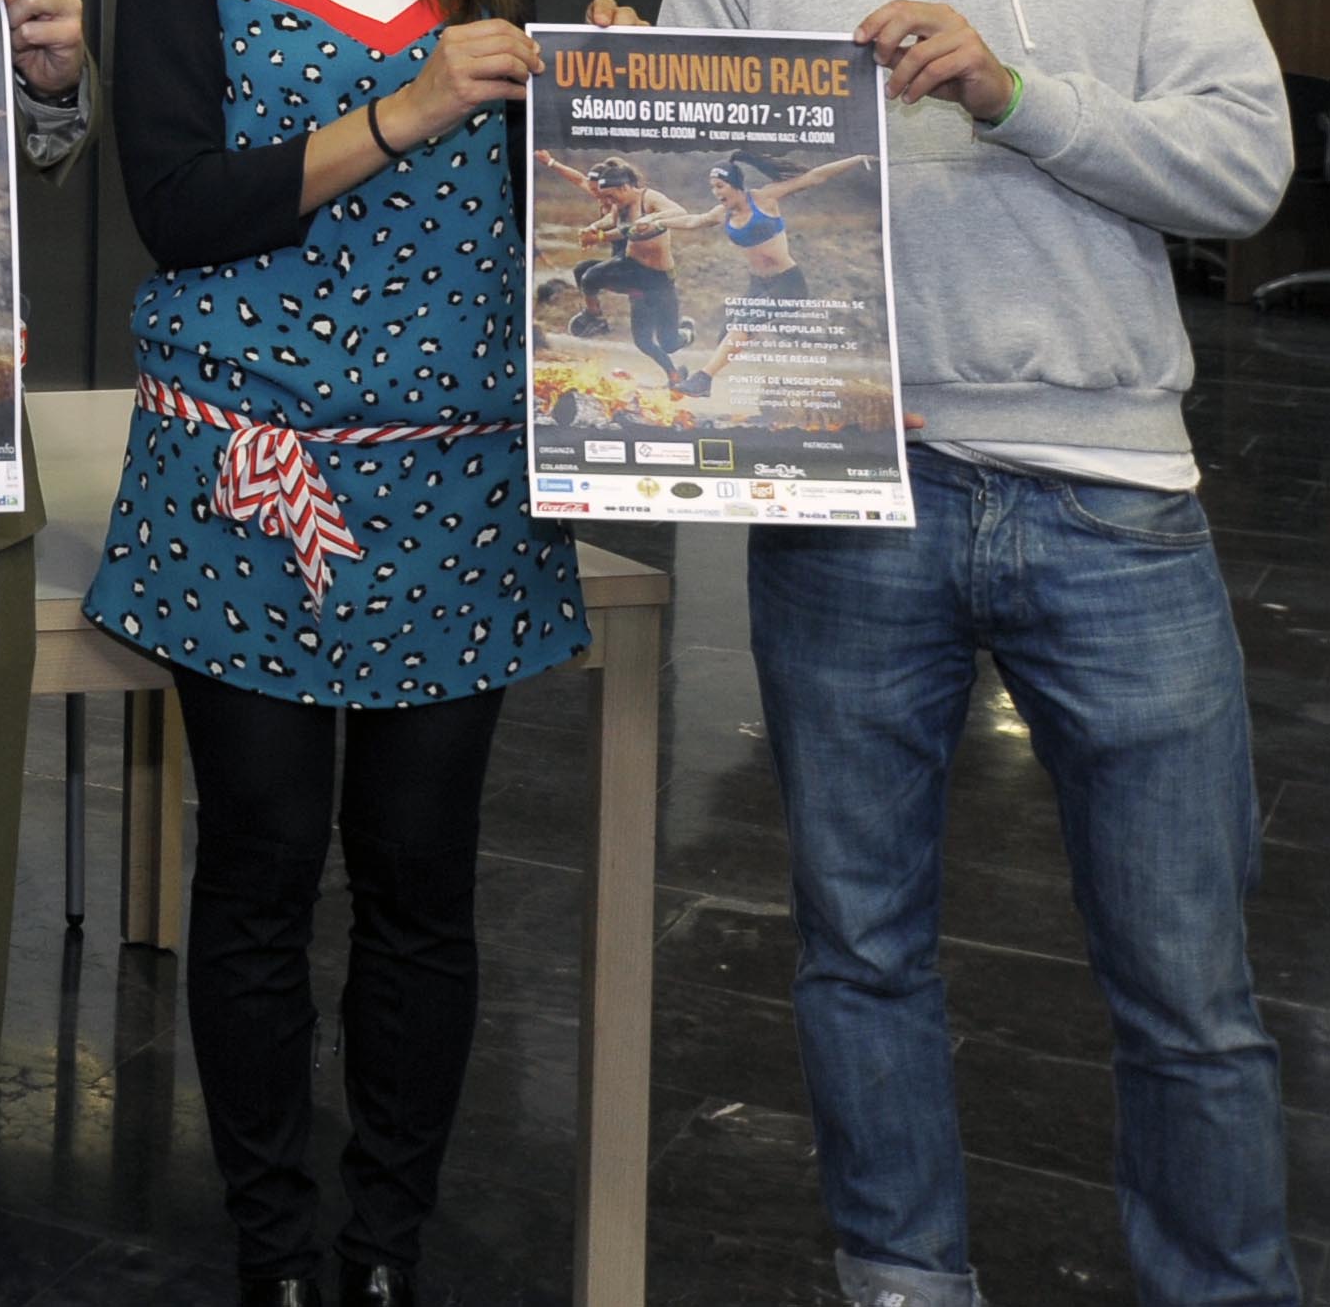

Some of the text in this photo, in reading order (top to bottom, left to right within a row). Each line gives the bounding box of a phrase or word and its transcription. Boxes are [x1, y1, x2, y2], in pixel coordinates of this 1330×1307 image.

[555, 50, 850, 97] UVA-RUNNING RACE
[571, 95, 635, 121] SÁBADO
[639, 99, 651, 121] 6
[654, 101, 674, 123] DE
[678, 101, 723, 124] MAYO
[727, 103, 771, 125] 2017
[787, 105, 835, 127] 17:30
[799, 131, 835, 144] 4.000M
[725, 295, 776, 307] CATEGORÍA
[726, 321, 777, 333] CATEGORÍA
[727, 353, 827, 365] CAMISETA DE REGALO
